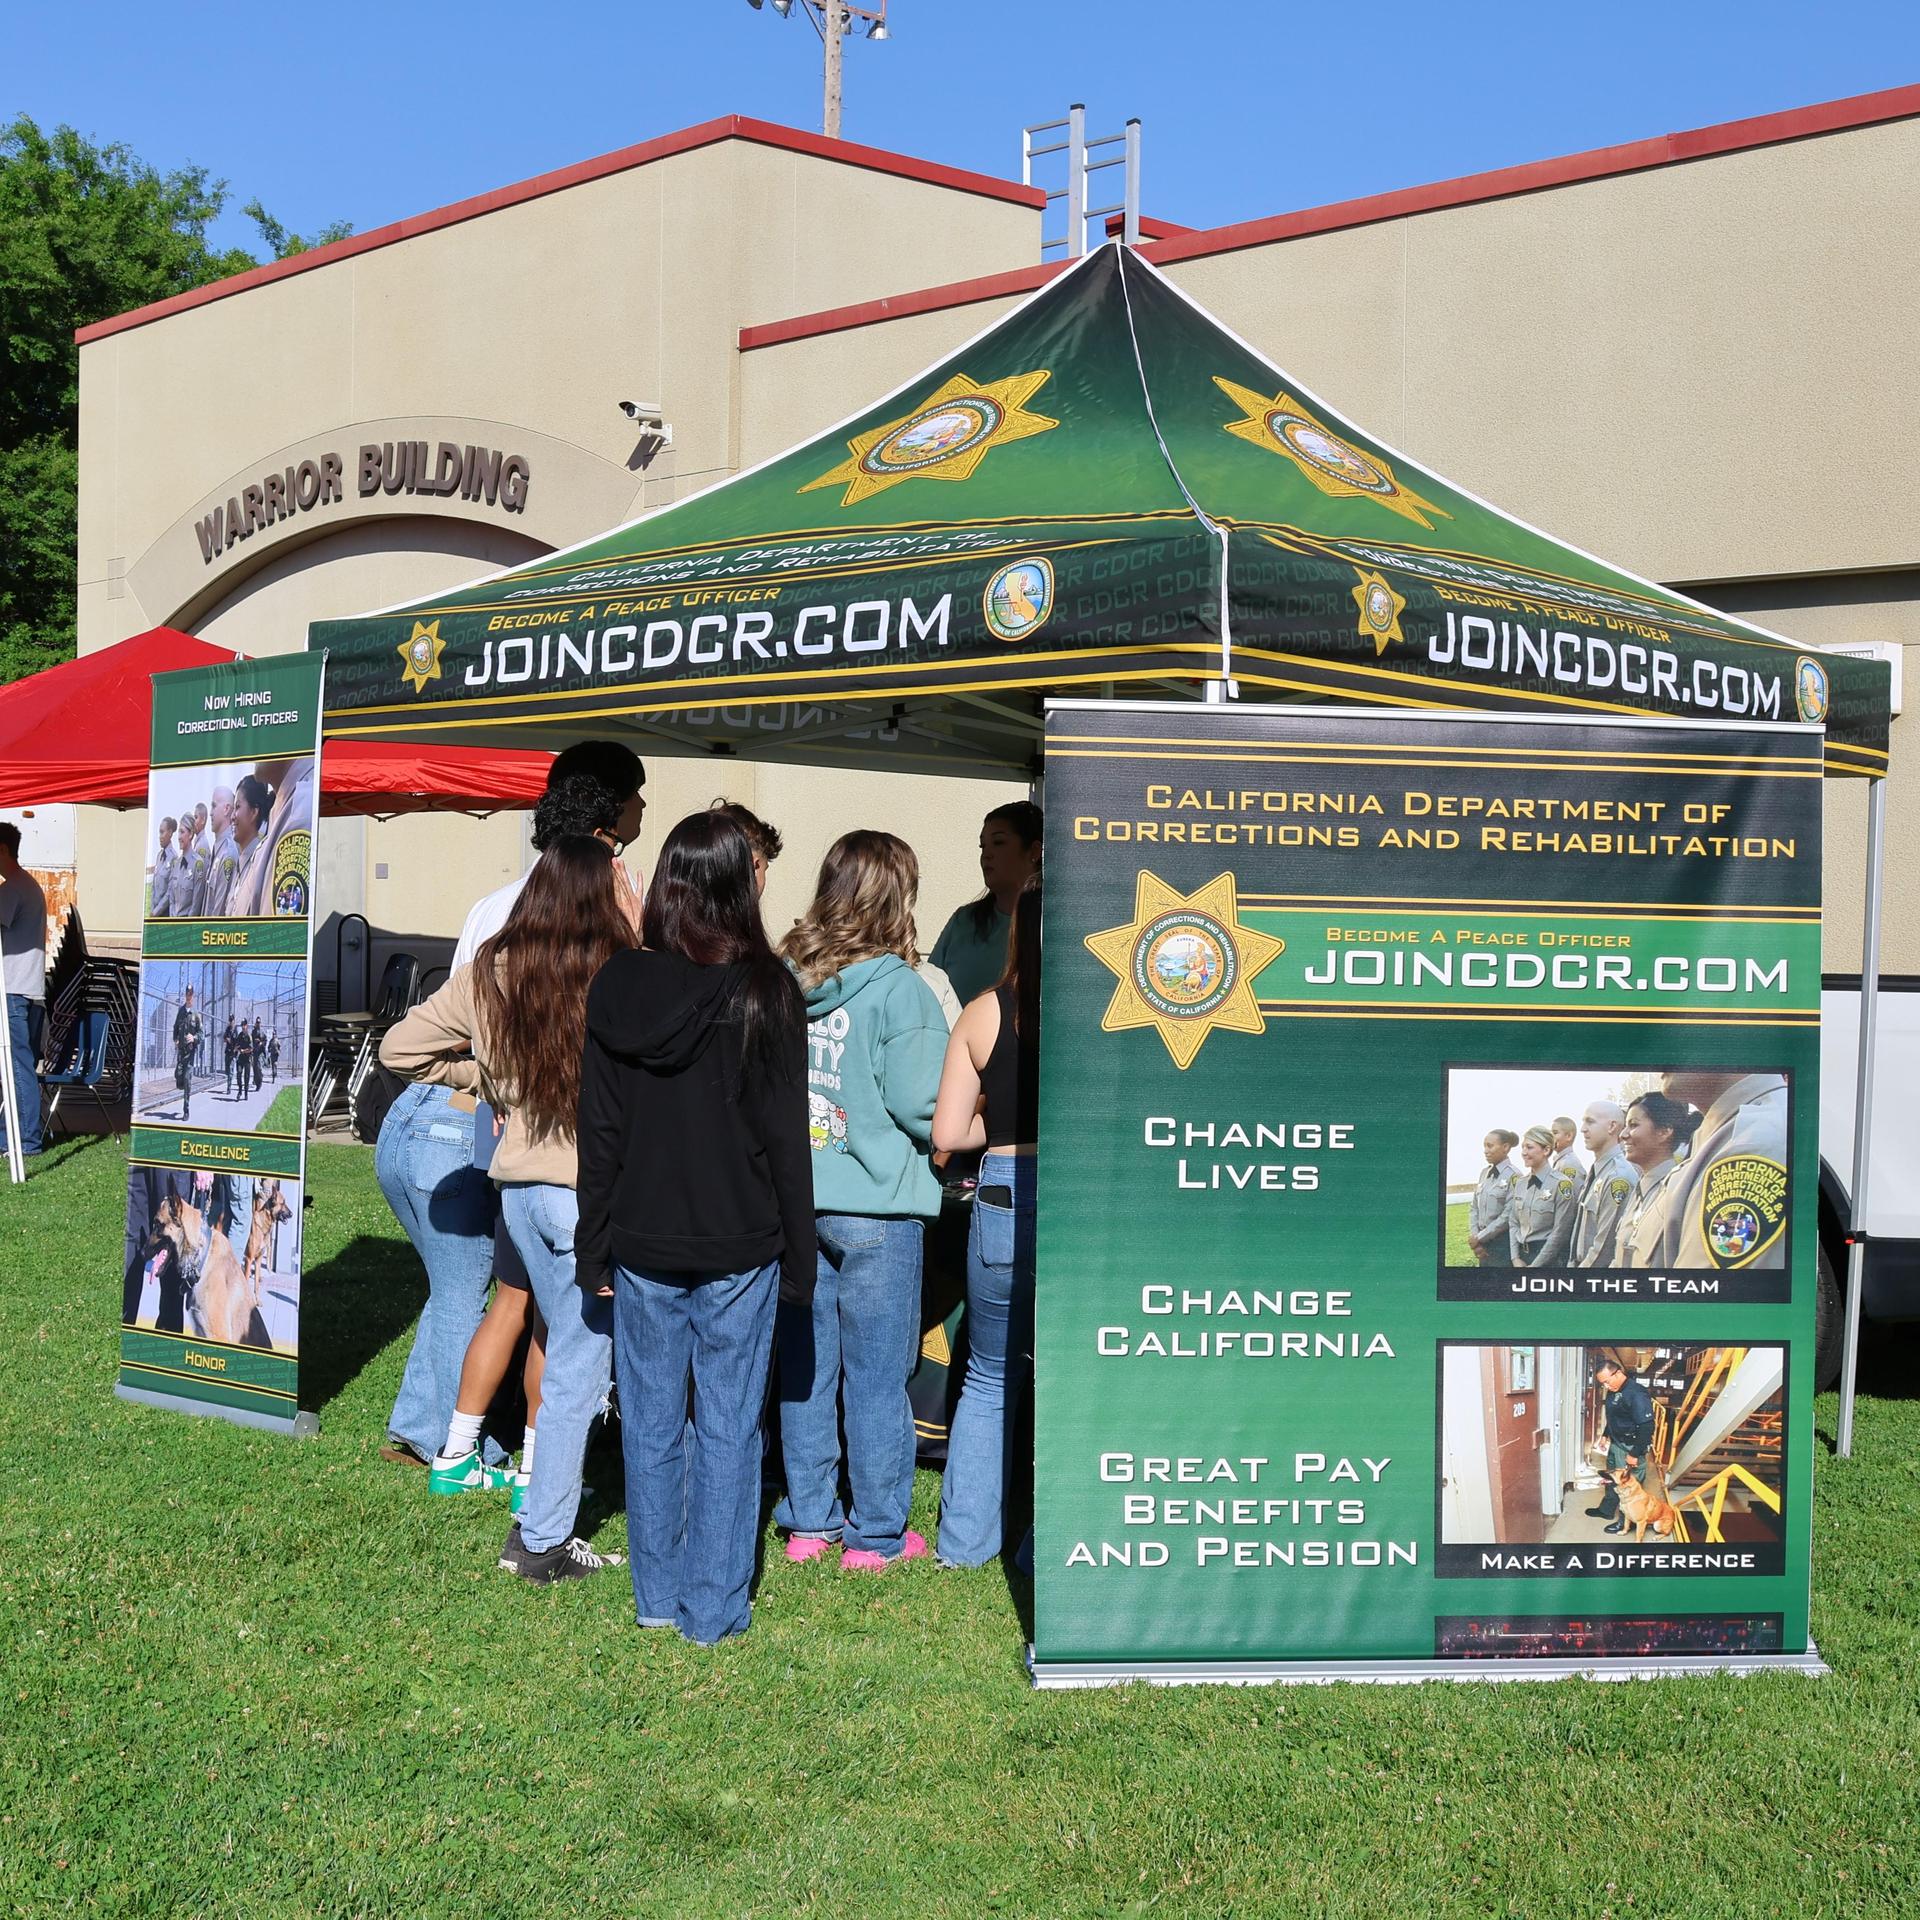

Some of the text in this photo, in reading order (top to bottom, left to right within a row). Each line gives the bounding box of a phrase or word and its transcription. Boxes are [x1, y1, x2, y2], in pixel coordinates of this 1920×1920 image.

[194, 441, 530, 565] WARRIOR BUILDING
[568, 532, 998, 582] CALIFORNIA DEPARTMENT OF
[504, 571, 695, 599] CORRECTIONS
[698, 563, 763, 576] AND
[488, 588, 782, 631] BECOME A PEACE OFFICER
[1432, 585, 1518, 612] BECOME
[1523, 602, 1540, 616] A
[1539, 607, 1600, 627] PEACE
[1605, 617, 1672, 643] OFFICER
[464, 593, 952, 686] JOINCDCR.COM
[1428, 611, 1781, 720] JOINCDCR.COM
[204, 691, 272, 711] NOW HIRING
[177, 710, 298, 735] CORRECTIONAL OFFICERS
[1147, 785, 1731, 824] CALIFORNIA DEPARTMENT OF
[1074, 817, 1795, 858] CORRECTIONS AND REHABILITATION
[202, 930, 248, 946] SERVICE
[1137, 915, 1235, 989] DEPARTMENT OF CORRECTIONS AND REHABILITATION
[1327, 927, 1632, 947] BECOME A PEACE OFFICER
[1304, 949, 1789, 993] JOINCDCR.COM
[1147, 992, 1222, 1014] STATE OF CALIFORNIA
[1144, 1117, 1355, 1150] CHANGE
[180, 1140, 251, 1161] EXCELLENCE
[1178, 1159, 1319, 1190] LIVES
[1710, 1171, 1787, 1197] DEPARTMENT OF
[1711, 1161, 1787, 1188] CALIFORNIA
[1705, 1189, 1778, 1224] REHABILITATION
[1707, 1180, 1784, 1213] CORRECTIONS &
[1141, 1284, 1352, 1316] CHANGE
[1511, 1276, 1719, 1294] JOIN THE TEAM
[1097, 1326, 1396, 1358] CALIFORNIA
[185, 1350, 226, 1372] HONOR
[1100, 1452, 1391, 1483] GREAT PAY
[1124, 1495, 1365, 1525] BENEFITS
[1065, 1537, 1417, 1567] AND PENSION
[1481, 1553, 1755, 1570] MAKE A DIFFERENCE
